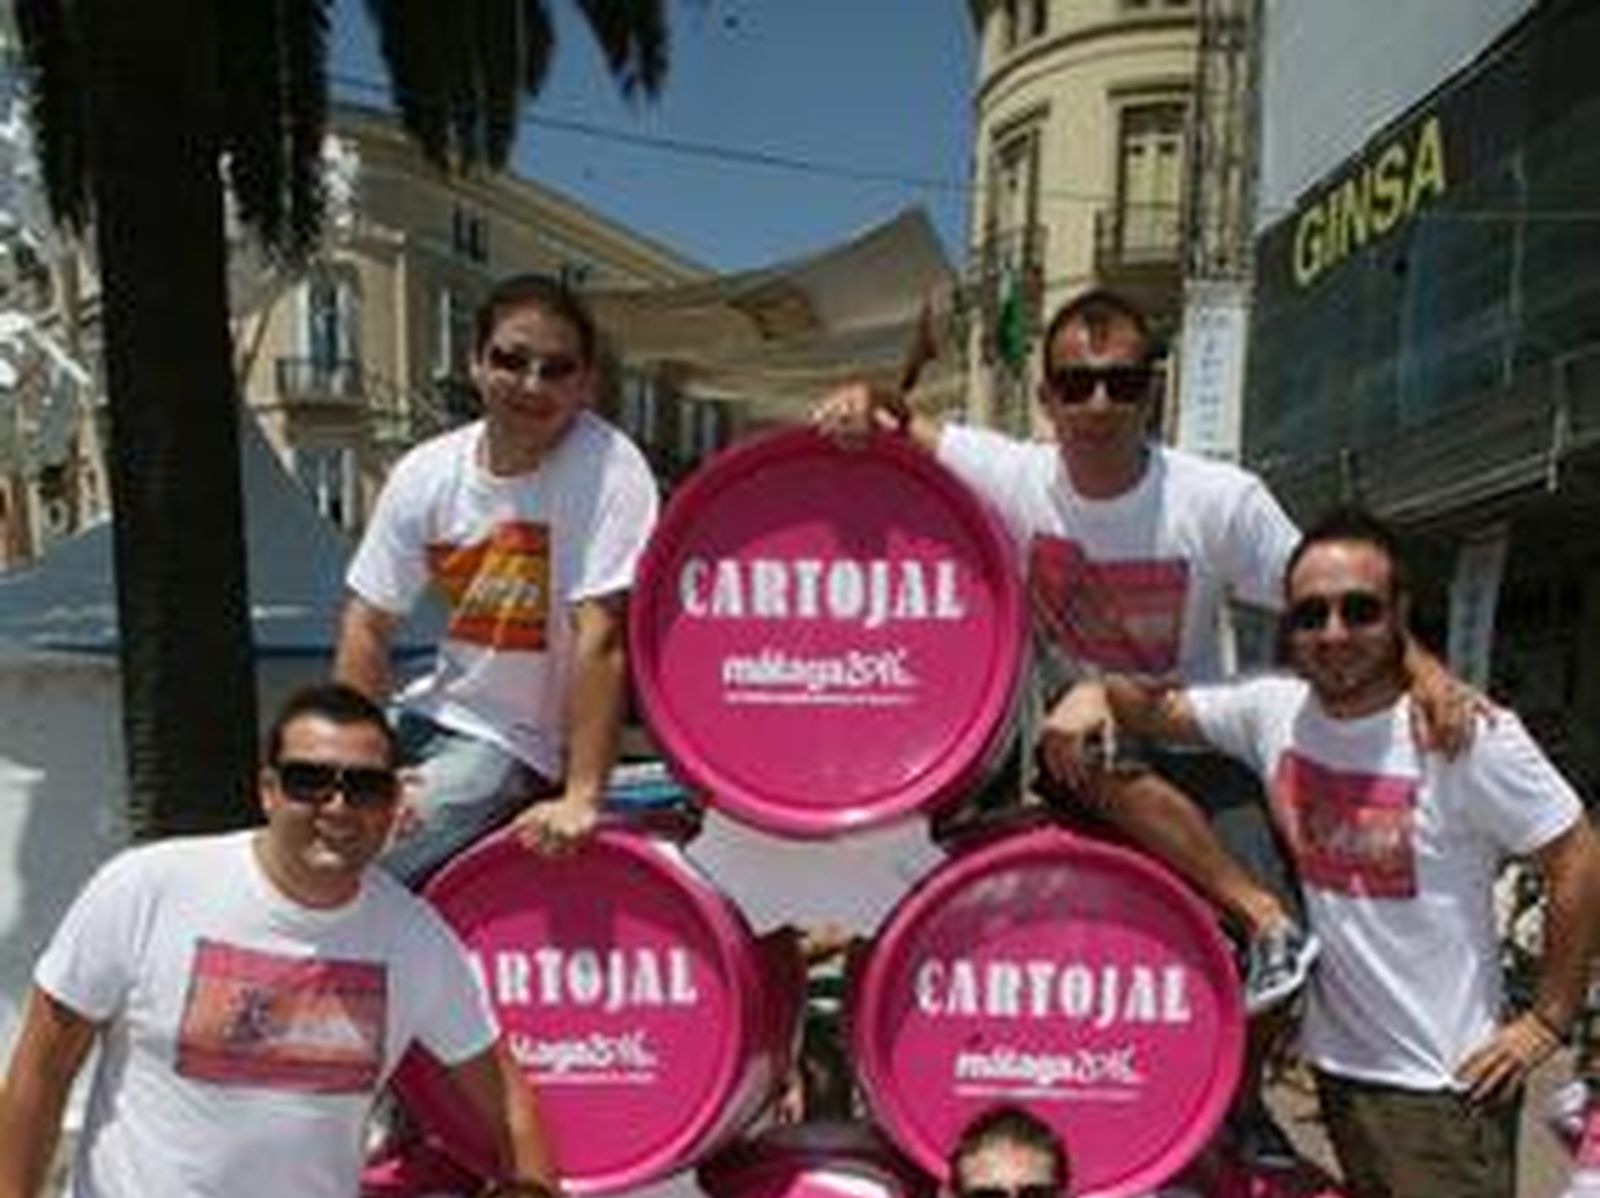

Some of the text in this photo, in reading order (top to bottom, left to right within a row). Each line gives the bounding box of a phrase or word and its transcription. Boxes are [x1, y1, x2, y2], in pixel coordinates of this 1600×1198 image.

[1294, 116, 1445, 286] GINSA
[679, 558, 964, 628] CARTOJAL
[916, 958, 1192, 1029] CARTOJAL
